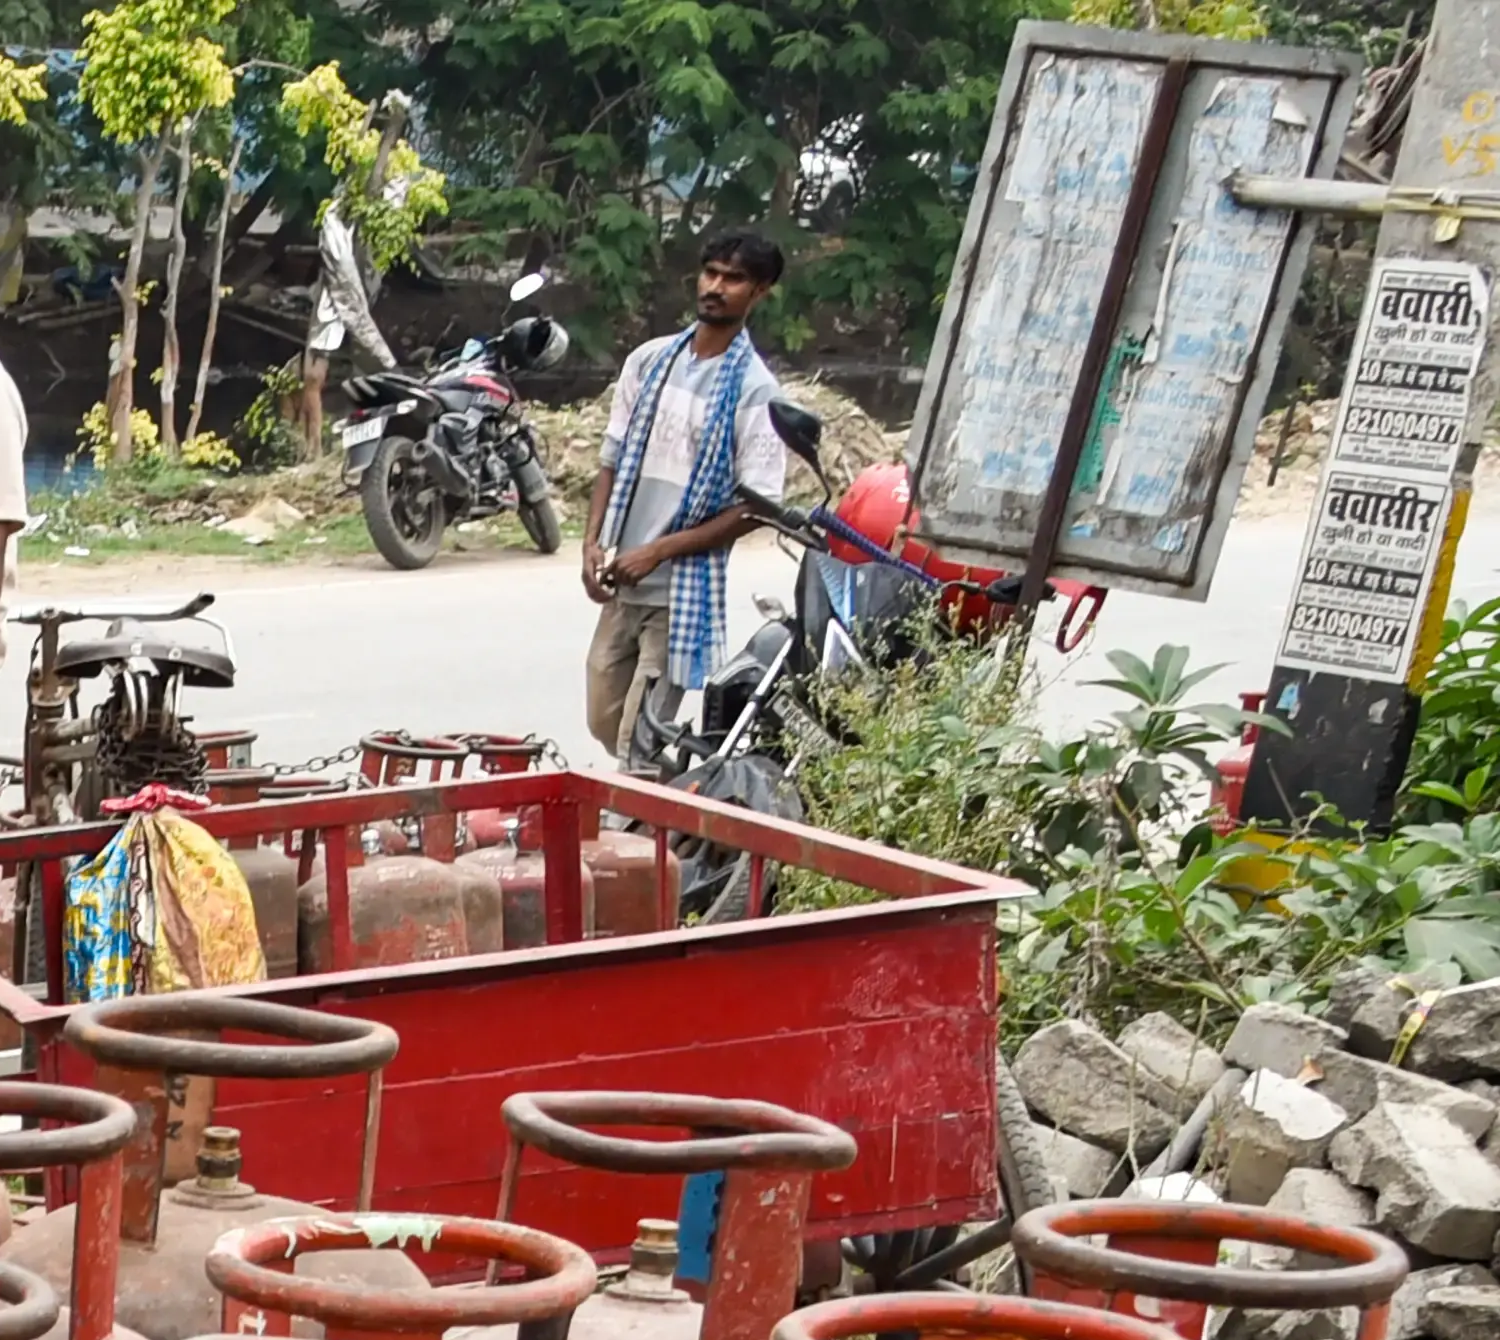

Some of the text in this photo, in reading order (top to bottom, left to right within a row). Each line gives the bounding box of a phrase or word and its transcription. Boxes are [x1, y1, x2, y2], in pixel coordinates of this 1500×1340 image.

[1360, 359, 1381, 383] 10
[1345, 407, 1461, 443] 8210904977
[1327, 486, 1441, 533] बवासीर
[1306, 558, 1328, 581] 10
[1291, 605, 1409, 647] 8210904977
